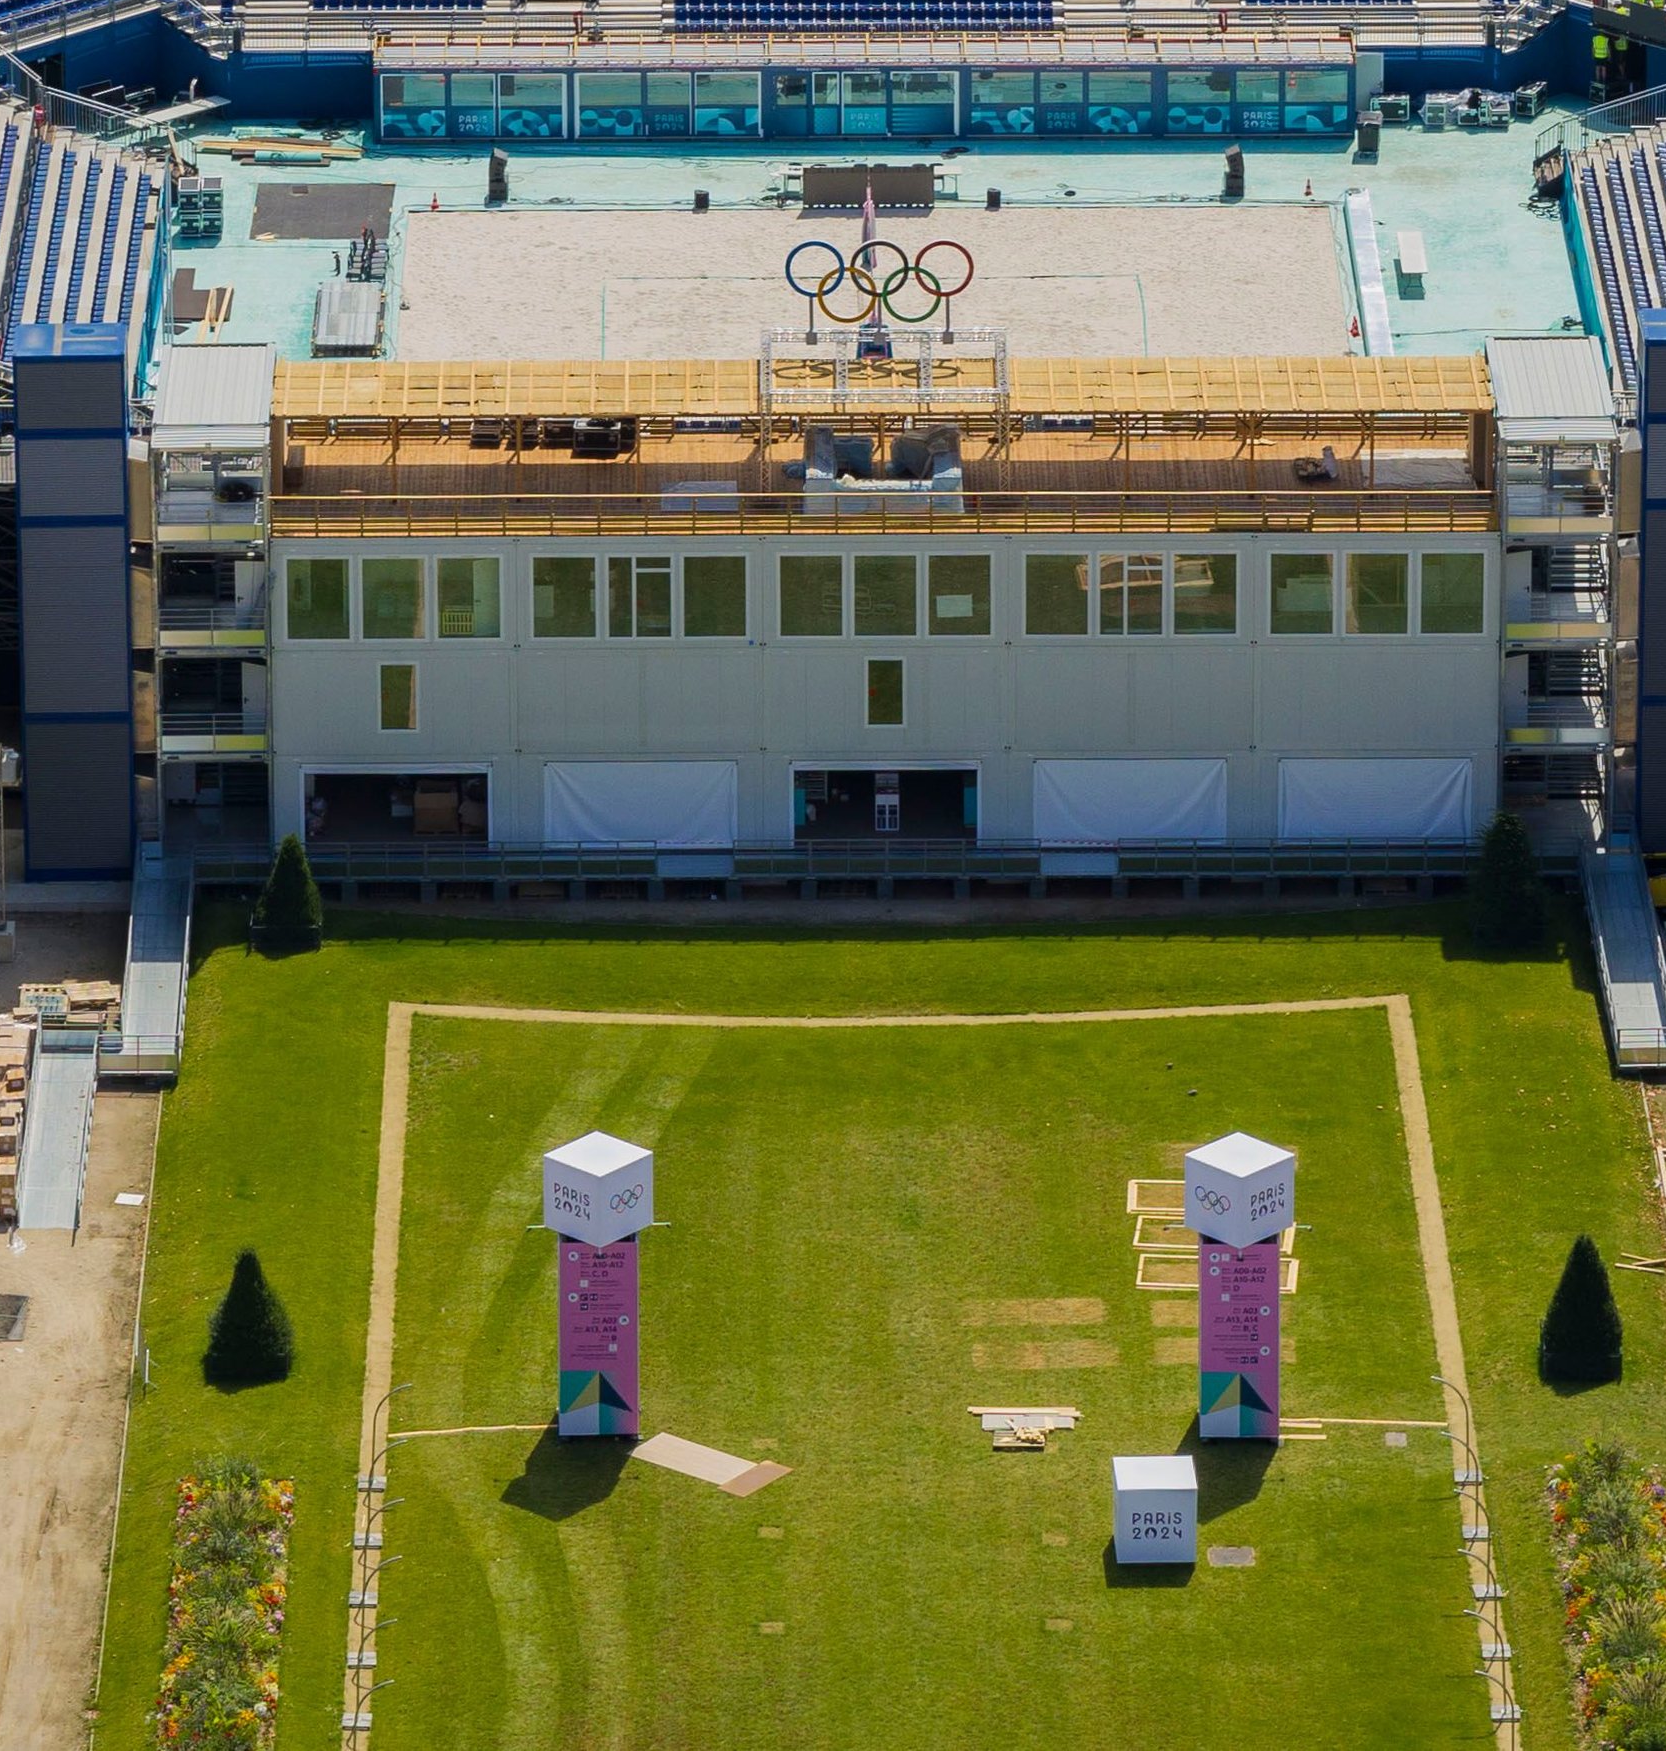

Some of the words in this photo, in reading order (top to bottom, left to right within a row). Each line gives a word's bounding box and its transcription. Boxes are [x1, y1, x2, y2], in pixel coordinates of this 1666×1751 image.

[458, 114, 488, 124] PARIS
[654, 114, 684, 122] PARIS
[1046, 111, 1077, 120] PARIS
[1243, 111, 1273, 120] PARIS
[554, 1182, 590, 1207] PARIS
[1250, 1182, 1285, 1208] PARIS
[554, 1197, 590, 1222] 2024
[1250, 1199, 1285, 1222] 2024
[1132, 1512, 1182, 1525] PARIS
[1132, 1526, 1182, 1540] 2024
